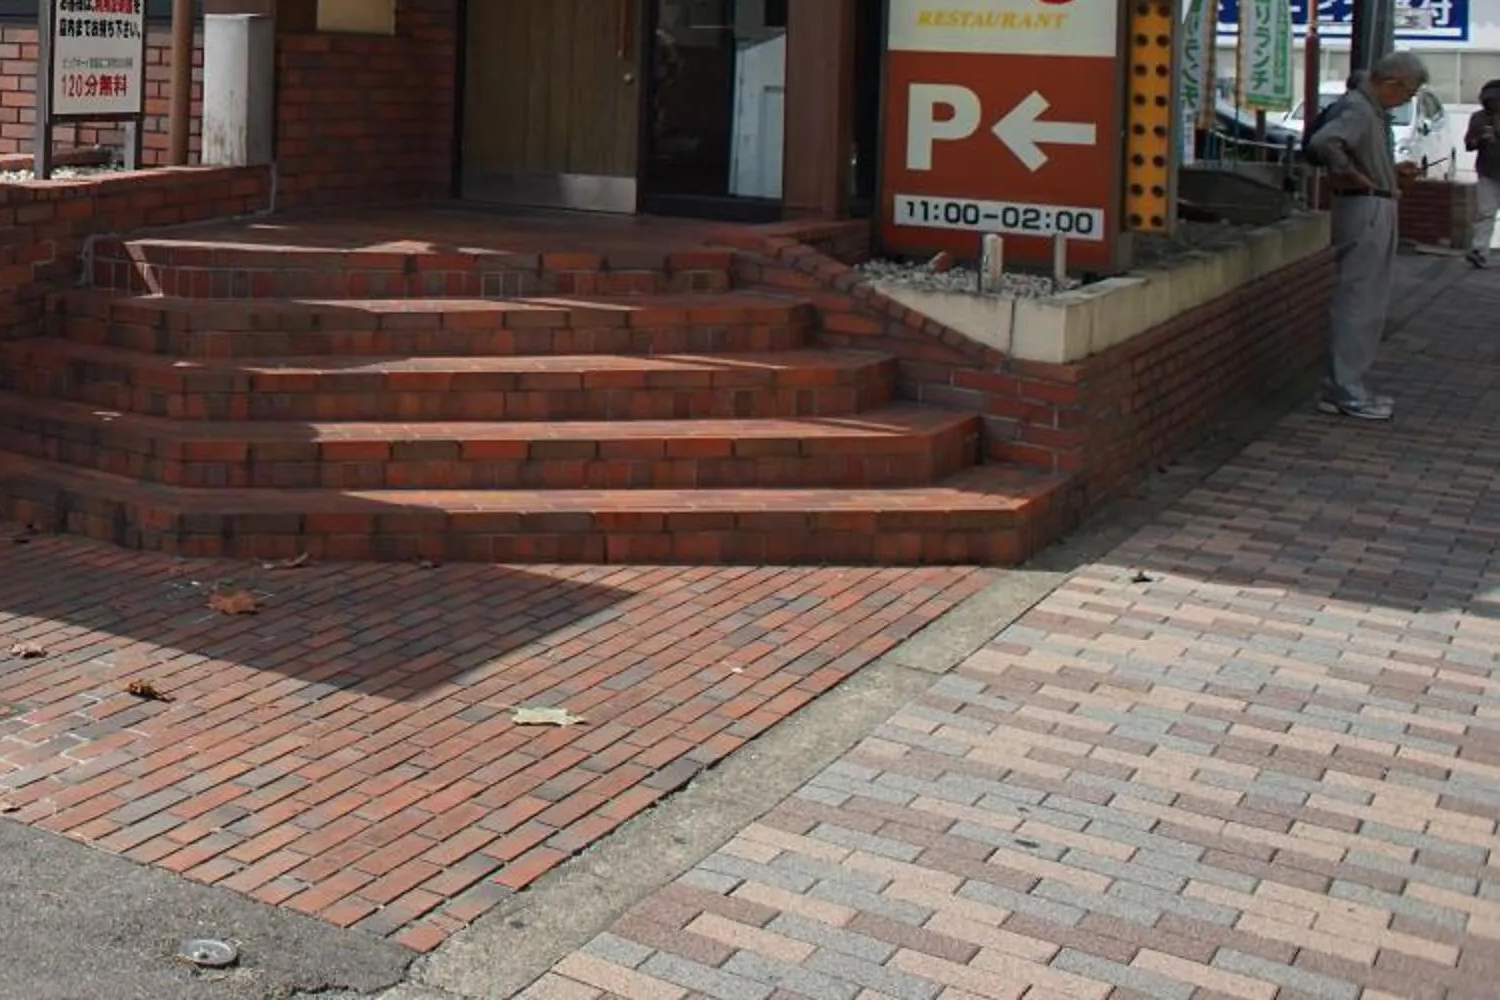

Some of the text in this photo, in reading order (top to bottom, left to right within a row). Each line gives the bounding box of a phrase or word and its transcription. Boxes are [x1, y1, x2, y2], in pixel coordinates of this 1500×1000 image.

[915, 10, 1069, 29] RESTAURANT
[61, 73, 129, 98] 120分無料
[906, 82, 982, 171] P
[906, 201, 1094, 235] 11:00-02:00
